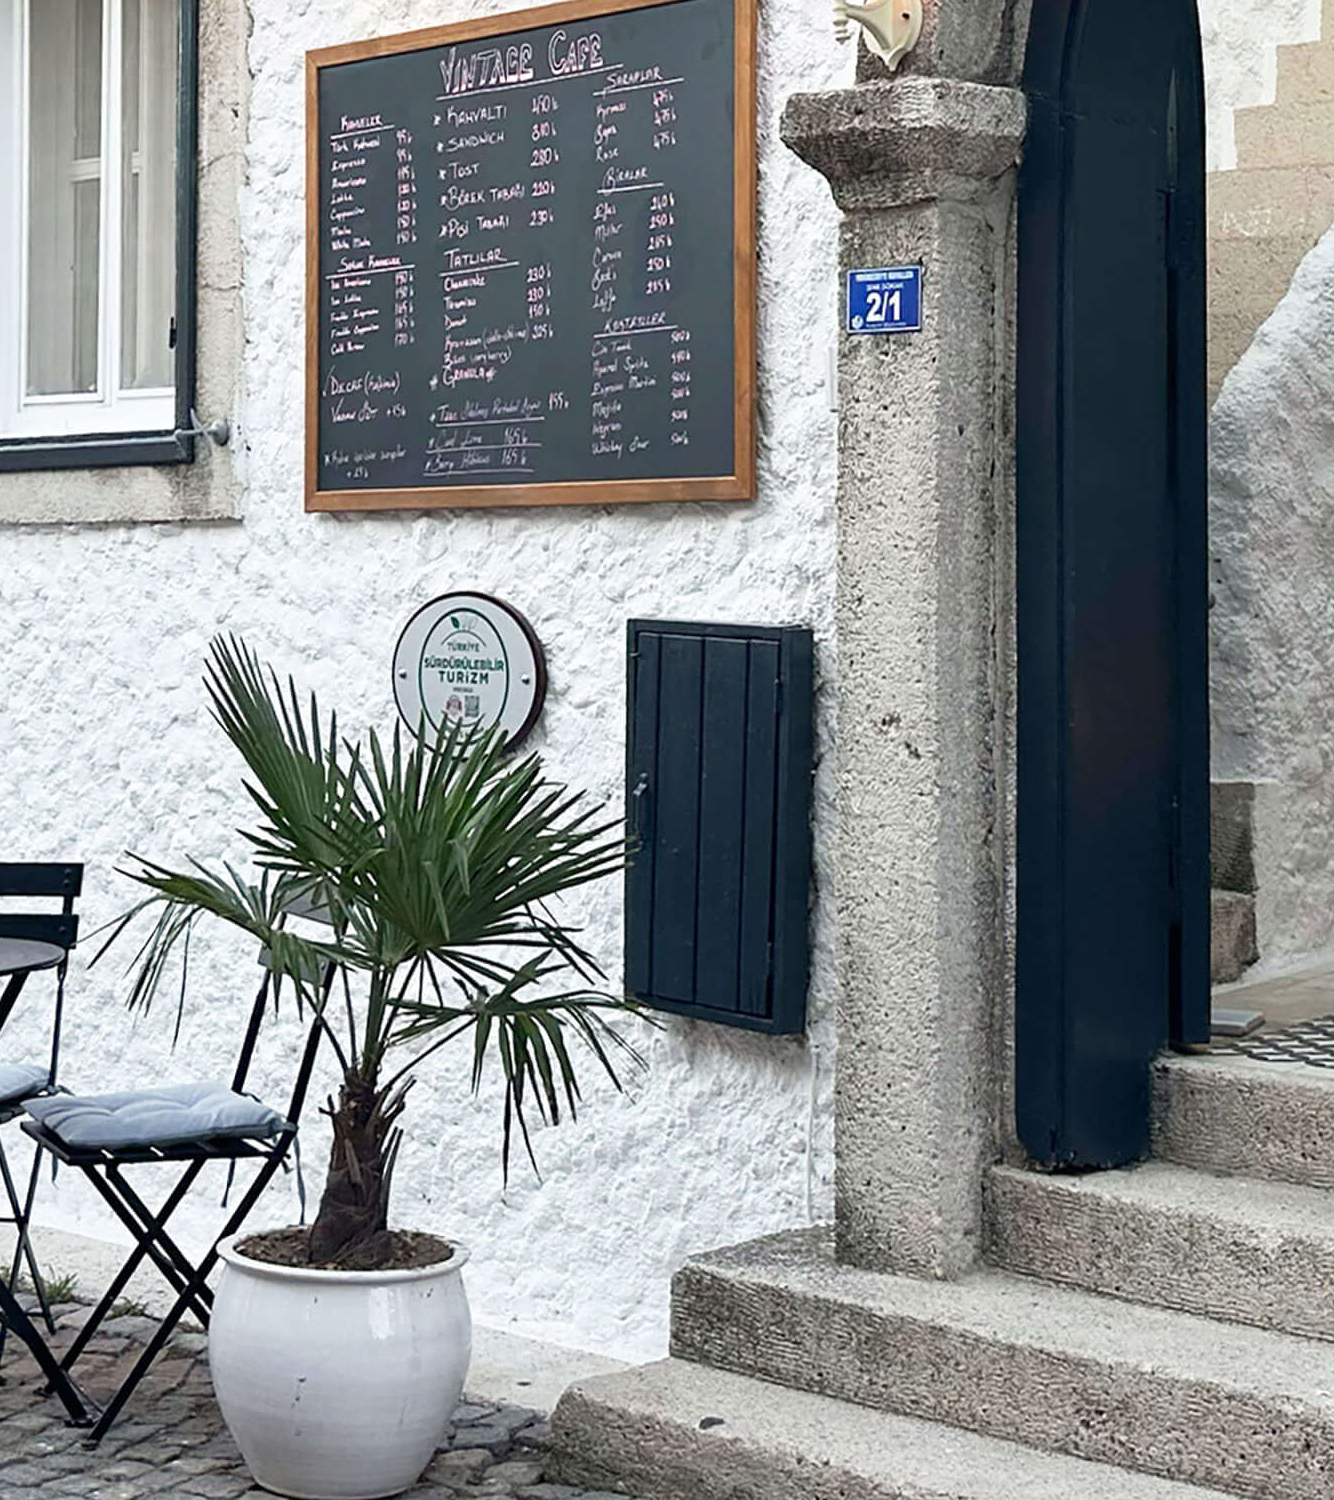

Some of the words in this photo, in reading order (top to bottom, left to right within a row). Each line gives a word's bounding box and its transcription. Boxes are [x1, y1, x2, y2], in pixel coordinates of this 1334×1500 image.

[440, 44, 534, 93] VINTAGE
[548, 29, 604, 75] CAFE
[447, 105, 507, 127] KAHVALTI
[447, 131, 504, 151] SANDWICH
[448, 162, 480, 179] TOST
[444, 248, 507, 269] TATLILAR
[866, 290, 901, 322] 2/1
